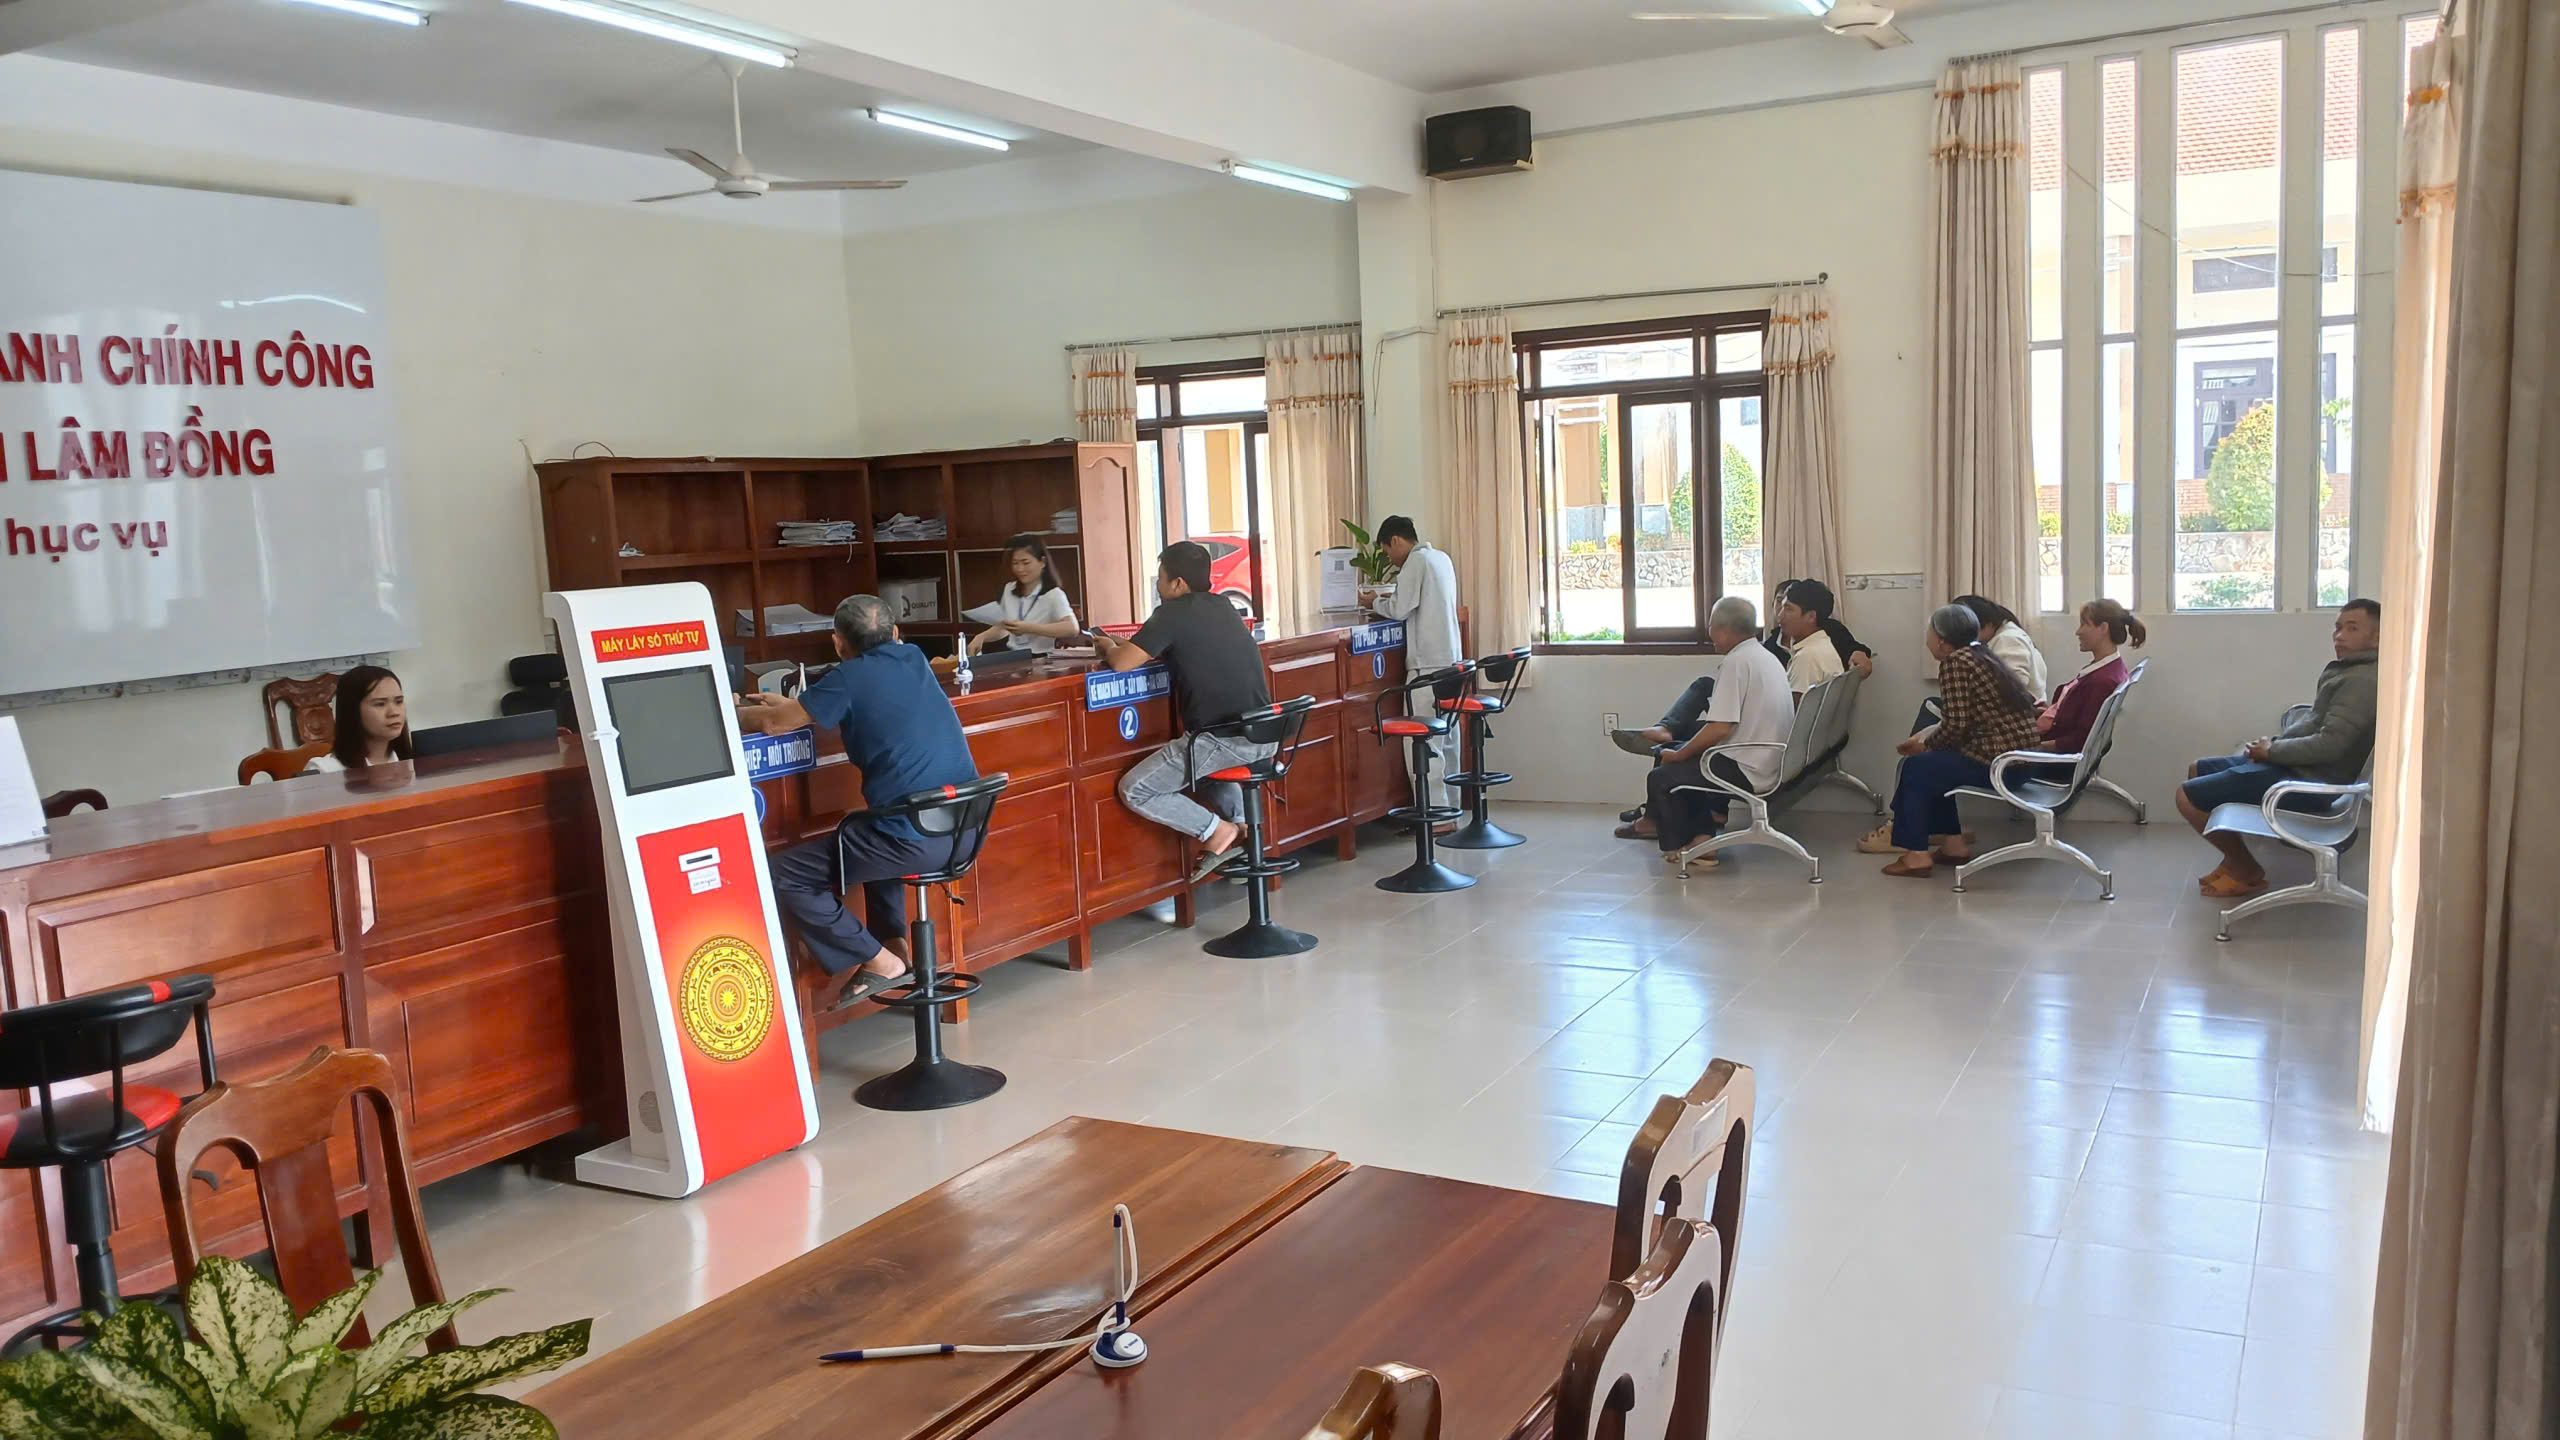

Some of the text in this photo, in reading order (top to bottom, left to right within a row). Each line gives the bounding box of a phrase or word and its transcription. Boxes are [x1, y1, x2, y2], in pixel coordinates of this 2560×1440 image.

[99, 323, 244, 386] CHÍNH
[256, 330, 374, 389] CÔNG
[23, 415, 131, 481] LÂM
[143, 405, 276, 479] ĐỒNG
[111, 520, 169, 557] vụ
[601, 636, 624, 653] MÁY
[1376, 655, 1382, 676] 1
[1124, 709, 1135, 738] 2
